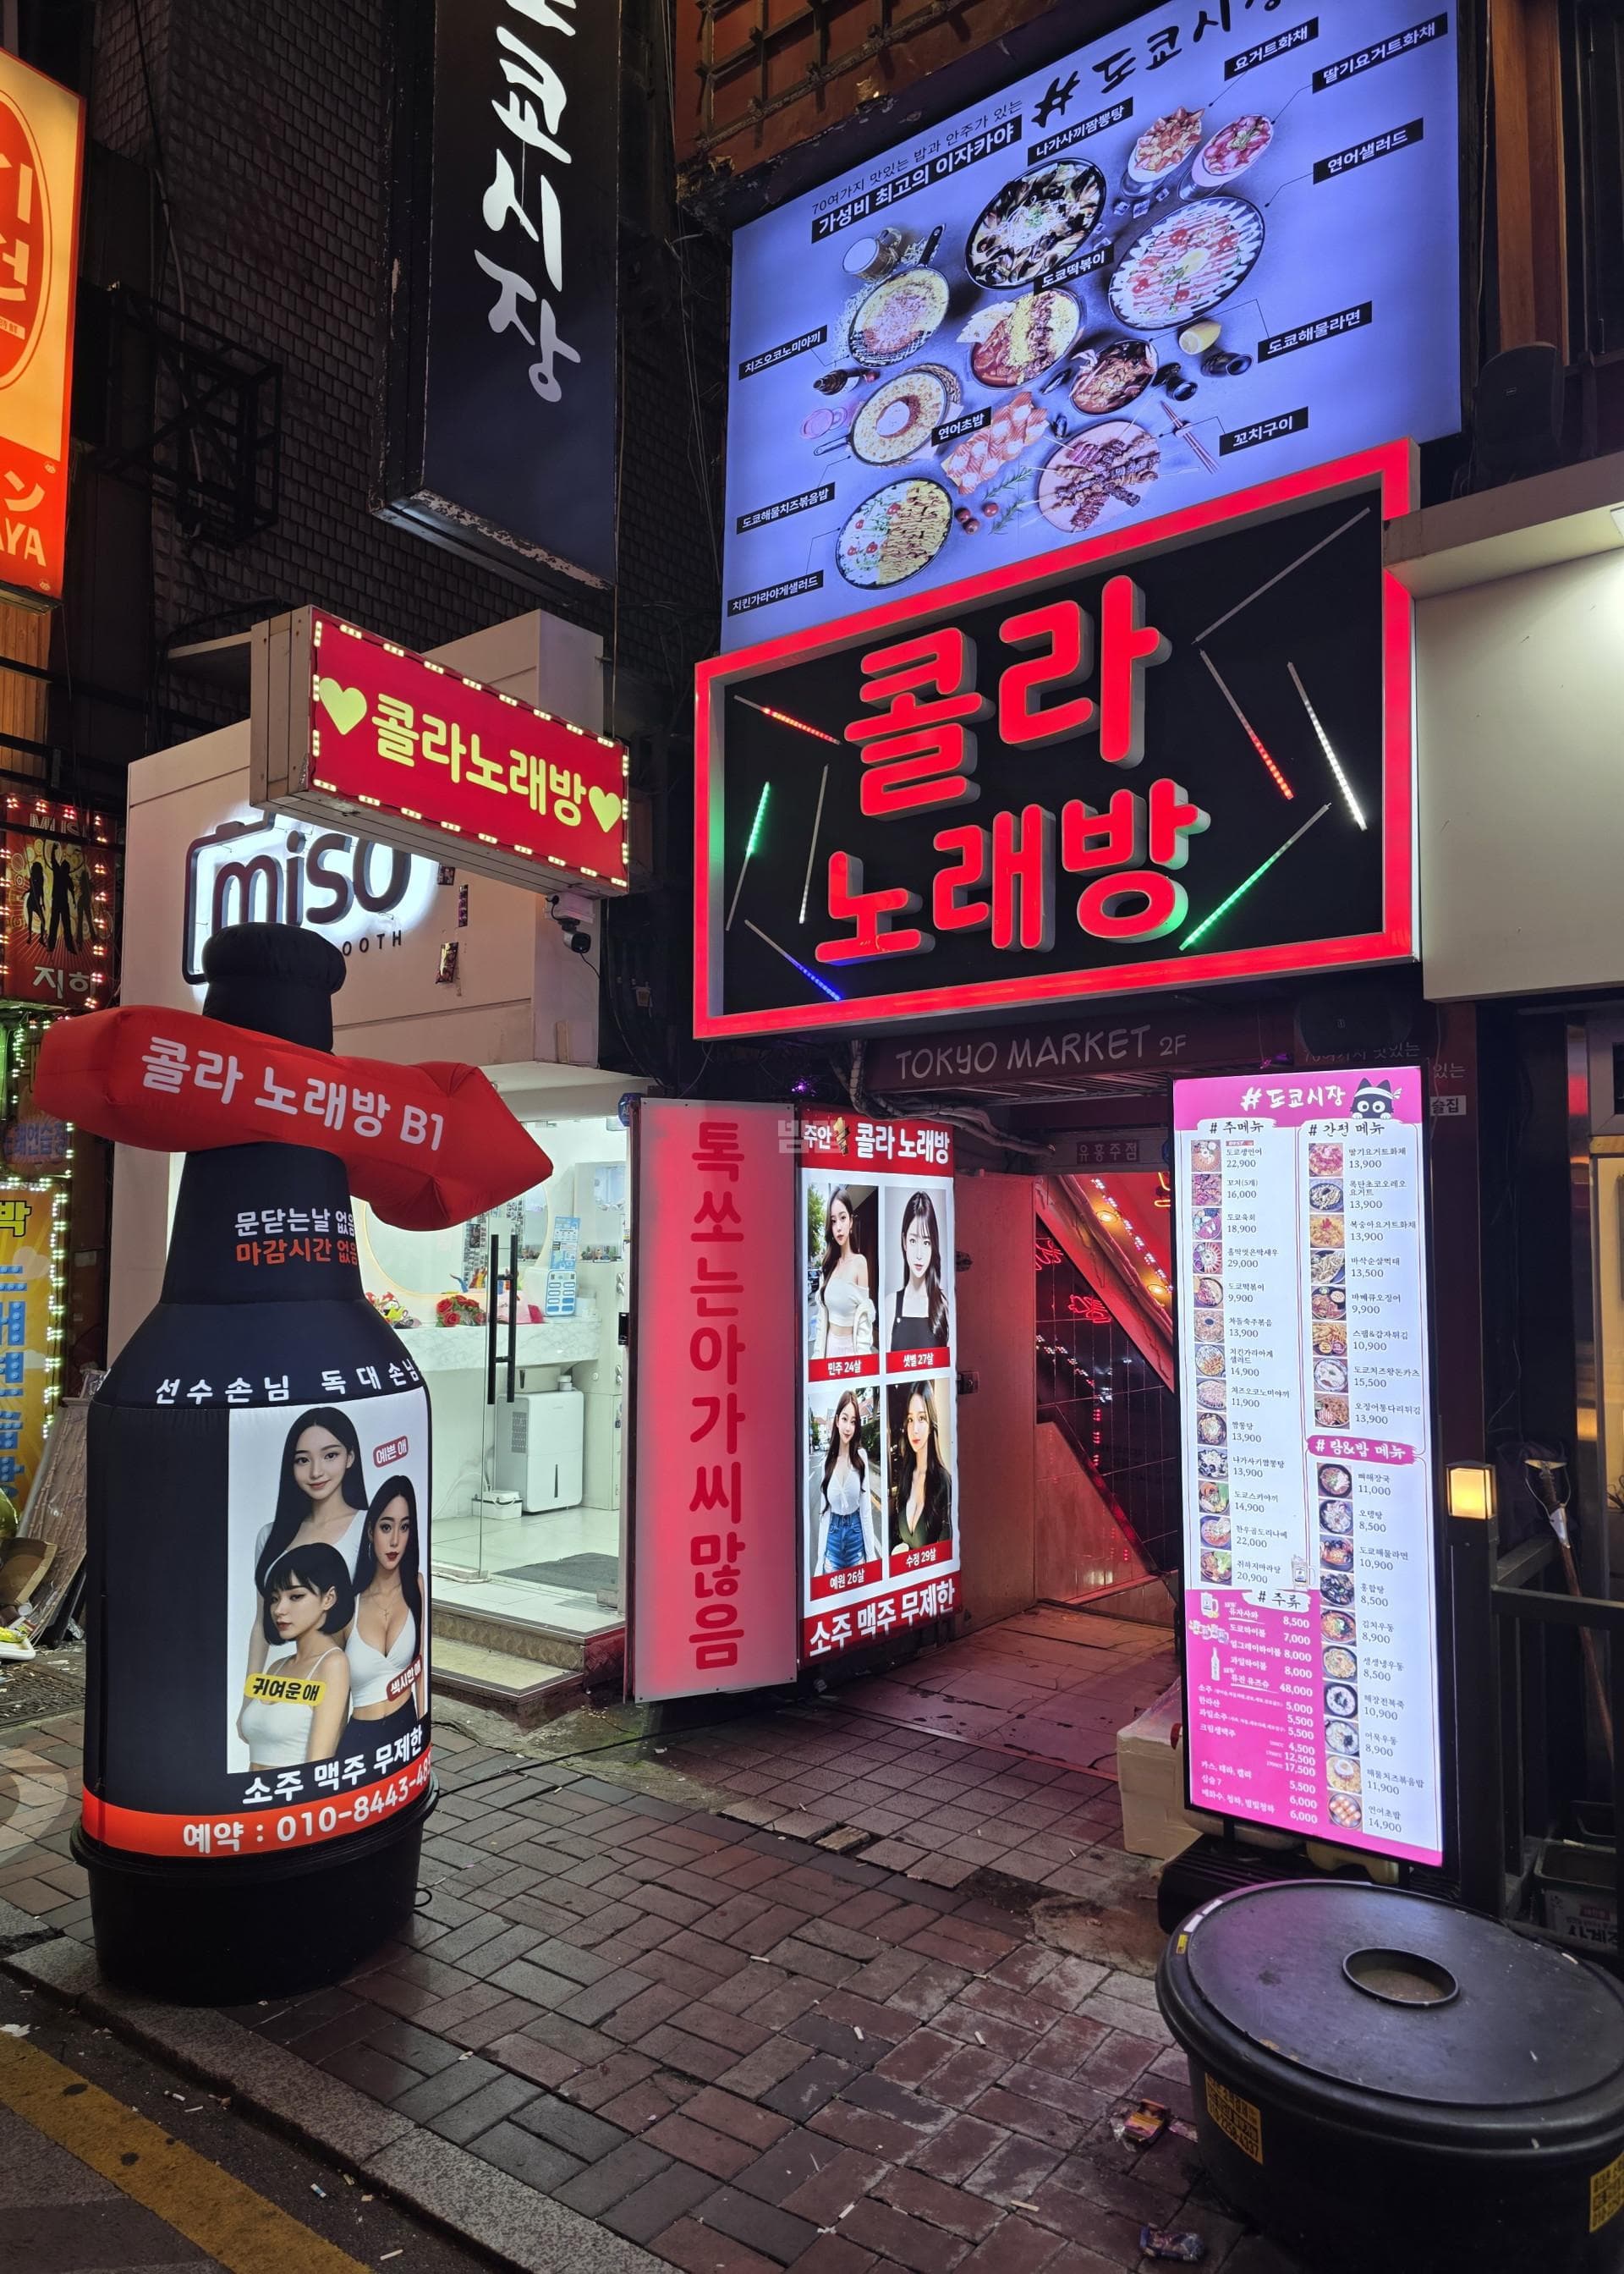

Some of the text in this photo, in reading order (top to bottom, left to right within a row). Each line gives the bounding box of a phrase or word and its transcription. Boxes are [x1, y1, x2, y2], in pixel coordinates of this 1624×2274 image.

[1092, 0, 1284, 94] 도쿄시
[1233, 25, 1309, 72] 요거트화채
[1324, 21, 1436, 83] 딸기요거트화채
[1036, 106, 1124, 156] 나가사끼짬뽕탕
[811, 99, 1023, 215] 70여가지 맛있는 밥과 안주가 있는
[1327, 130, 1408, 174] 연어샐러드
[819, 124, 1014, 235] 가성비 최고의 이자카야
[1041, 251, 1106, 288] 도쿄떡볶이
[1267, 310, 1361, 355] 도쿄해물라면
[744, 332, 821, 374] 치즈오코노미야끼
[938, 414, 985, 440] 연어초밥
[1232, 416, 1293, 448] 꼬치구이
[742, 487, 829, 528] 도쿄해물치즈볶음밥
[844, 575, 1161, 817] 콜라
[372, 692, 587, 827] 콜라노래방
[815, 777, 1200, 964] 노래방
[342, 930, 403, 957] OOTH
[896, 1024, 1187, 1080] TOKYO MARKET 2F
[142, 1036, 445, 1151] 콜라 노래방 B1
[1223, 1119, 1265, 1134] 주메뉴
[1323, 1121, 1385, 1137] 간편 메뉴
[804, 1123, 951, 1165] 주안 콜라 노래방
[1078, 1142, 1138, 1163] 유흥주점
[1226, 1159, 1257, 1168] 22,900
[1349, 1160, 1382, 1169] 13,900
[1227, 1190, 1257, 1200] 16,000
[1350, 1200, 1383, 1210] 13,900
[235, 1207, 332, 1237] 문닫는날
[1227, 1225, 1257, 1233] 18,900
[1351, 1233, 1384, 1242] 13,900
[236, 1237, 332, 1266] 마감시간
[1227, 1260, 1259, 1269] 29,000
[1352, 1269, 1384, 1278] 13,500
[1228, 1294, 1254, 1303] 9,900
[1352, 1305, 1380, 1315] 9,900
[1229, 1329, 1259, 1338] 13,900
[1353, 1342, 1387, 1352] 10,900
[918, 1352, 934, 1365] 27살
[827, 1359, 862, 1376] 민주 24살
[1231, 1367, 1259, 1377] 14,900
[1354, 1377, 1387, 1388] 15,500
[1232, 1398, 1260, 1408] 11,900
[1355, 1414, 1388, 1425] 13,900
[1232, 1433, 1262, 1443] 13,900
[1374, 1443, 1406, 1460] 메뉴
[1233, 1468, 1263, 1478] 13,900
[1358, 1485, 1391, 1496] 11,000
[1235, 1502, 1265, 1513] 14,900
[1358, 1521, 1386, 1532] 8,500
[1237, 1536, 1267, 1548] 22,000
[905, 1547, 936, 1567] 수정 29살
[1359, 1558, 1394, 1571] 10,900
[830, 1568, 865, 1590] 예원 26살
[1237, 1571, 1268, 1584] 20,900
[1272, 1592, 1301, 1611] 주류
[1360, 1595, 1389, 1607] 8,500
[809, 1579, 956, 1657] 소주 맥주 무제한
[1283, 1616, 1310, 1629] 8,500
[1283, 1633, 1311, 1645] 7,000
[1362, 1632, 1391, 1644] 8,900
[1284, 1649, 1312, 1662] 8,000
[1284, 1666, 1313, 1679] 8,000
[1363, 1669, 1391, 1681] 8,500
[1279, 1683, 1313, 1697] 48,000
[1286, 1701, 1314, 1714] 5,000
[1364, 1706, 1398, 1721] 10,900
[1287, 1714, 1314, 1727] 5,500
[1287, 1727, 1314, 1740] 5,500
[1288, 1742, 1315, 1755] 4,500
[1365, 1744, 1393, 1757] 8,900
[242, 1724, 423, 1805] 소주 맥주 무제한
[1284, 1752, 1316, 1766] 12,500
[1285, 1762, 1316, 1777] 17,500
[1289, 1780, 1316, 1794] 5,500
[1367, 1781, 1400, 1795] 11,900
[1289, 1795, 1317, 1810] 6,000
[1290, 1810, 1318, 1824] 6,000
[1369, 1818, 1402, 1833] 14,900
[183, 1821, 244, 1854] 예약
